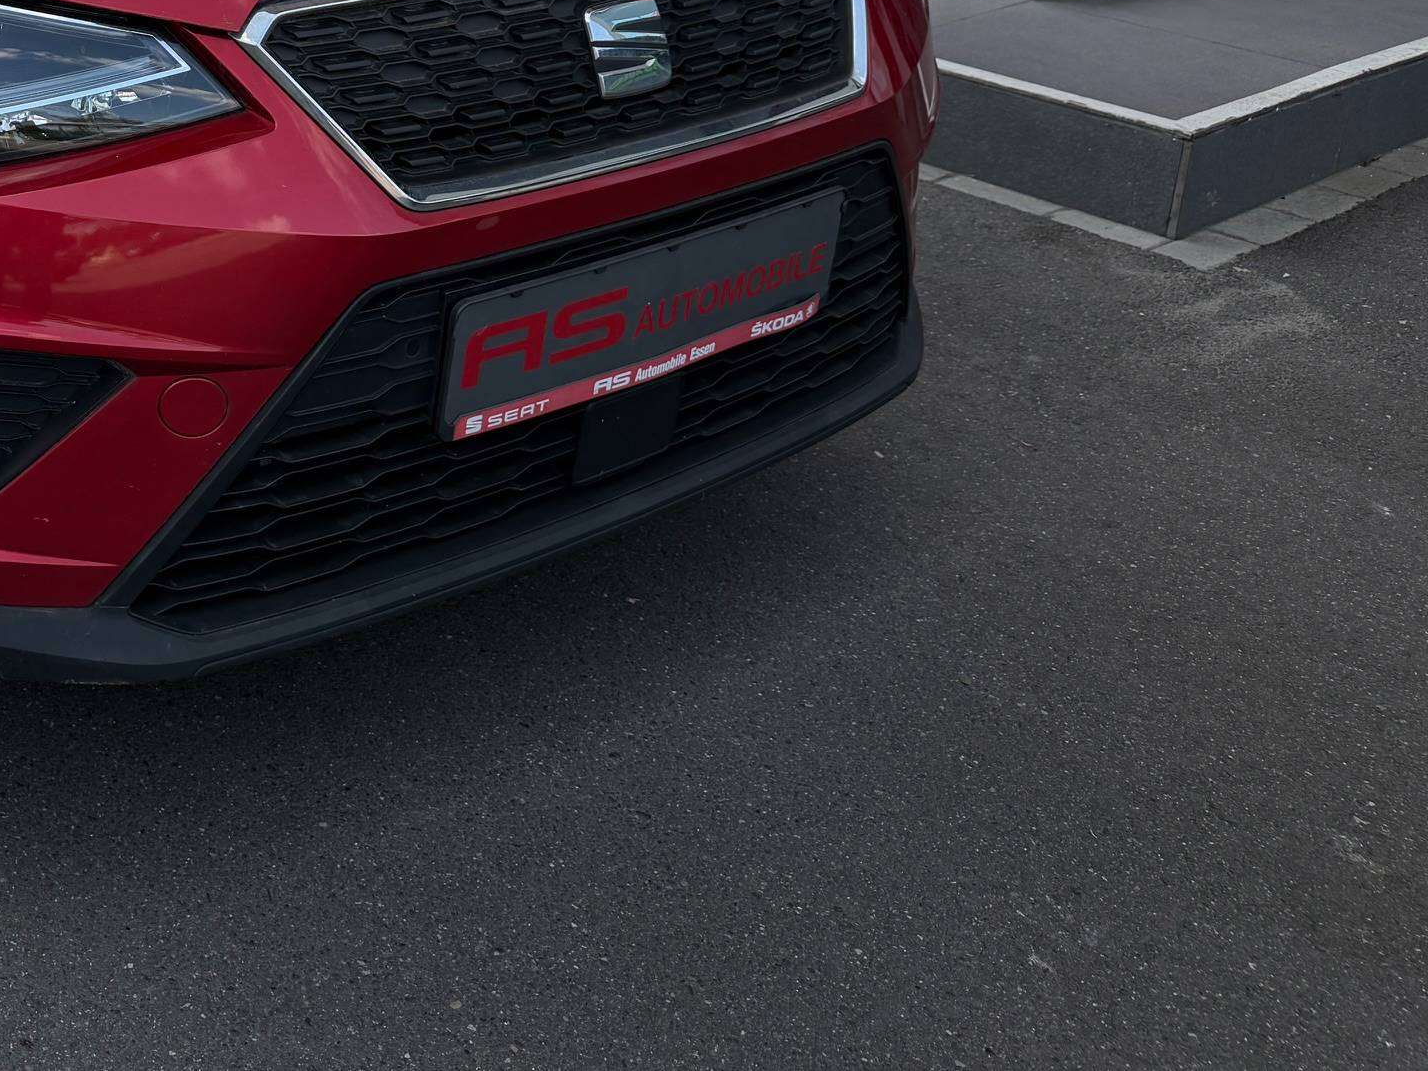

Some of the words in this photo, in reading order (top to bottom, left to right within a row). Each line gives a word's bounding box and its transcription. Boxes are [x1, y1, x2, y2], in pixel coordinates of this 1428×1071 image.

[460, 286, 629, 389] AS
[632, 242, 828, 343] AUTOMOBILE
[487, 399, 549, 428] SEAT
[593, 371, 632, 395] AS
[635, 353, 687, 382] Automobile
[689, 342, 716, 361] Essen
[750, 313, 804, 337] ŠKODA
